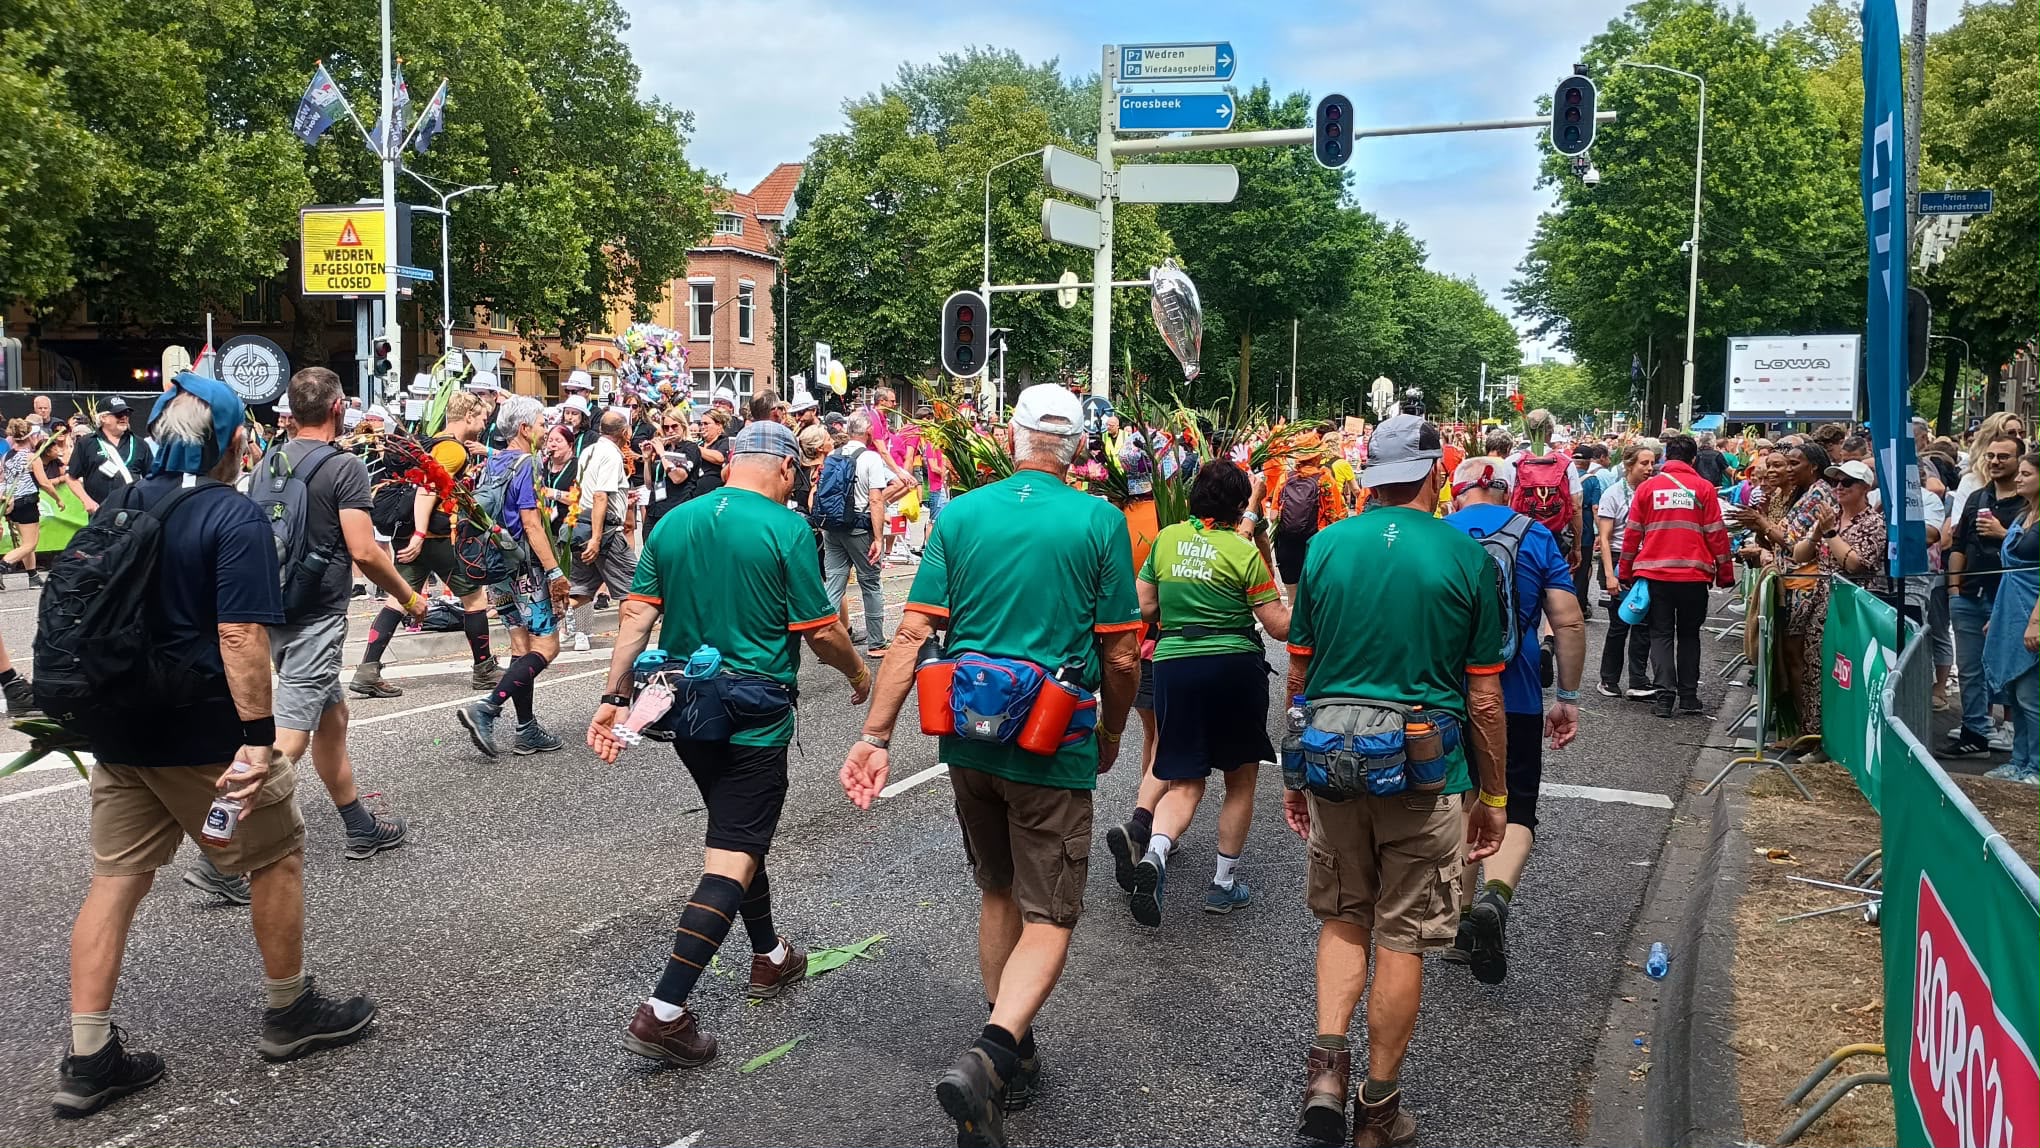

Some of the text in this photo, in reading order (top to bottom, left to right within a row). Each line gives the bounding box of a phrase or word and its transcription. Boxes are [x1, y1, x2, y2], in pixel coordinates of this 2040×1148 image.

[1128, 50, 1185, 60] P7 Wedren
[1127, 64, 1215, 75] P8 Vierdaagseplein
[1122, 99, 1181, 109] Groesbeek
[1921, 203, 1988, 211] Bernhardstraat
[323, 249, 373, 261] WEDREN
[312, 263, 385, 275] AFGESLOTEN
[327, 277, 371, 289] CLOSED
[1755, 359, 1830, 369] LOWA
[235, 366, 268, 376] AWB
[1177, 541, 1218, 561] Walk
[1181, 556, 1207, 568] of the
[1171, 563, 1213, 581] World
